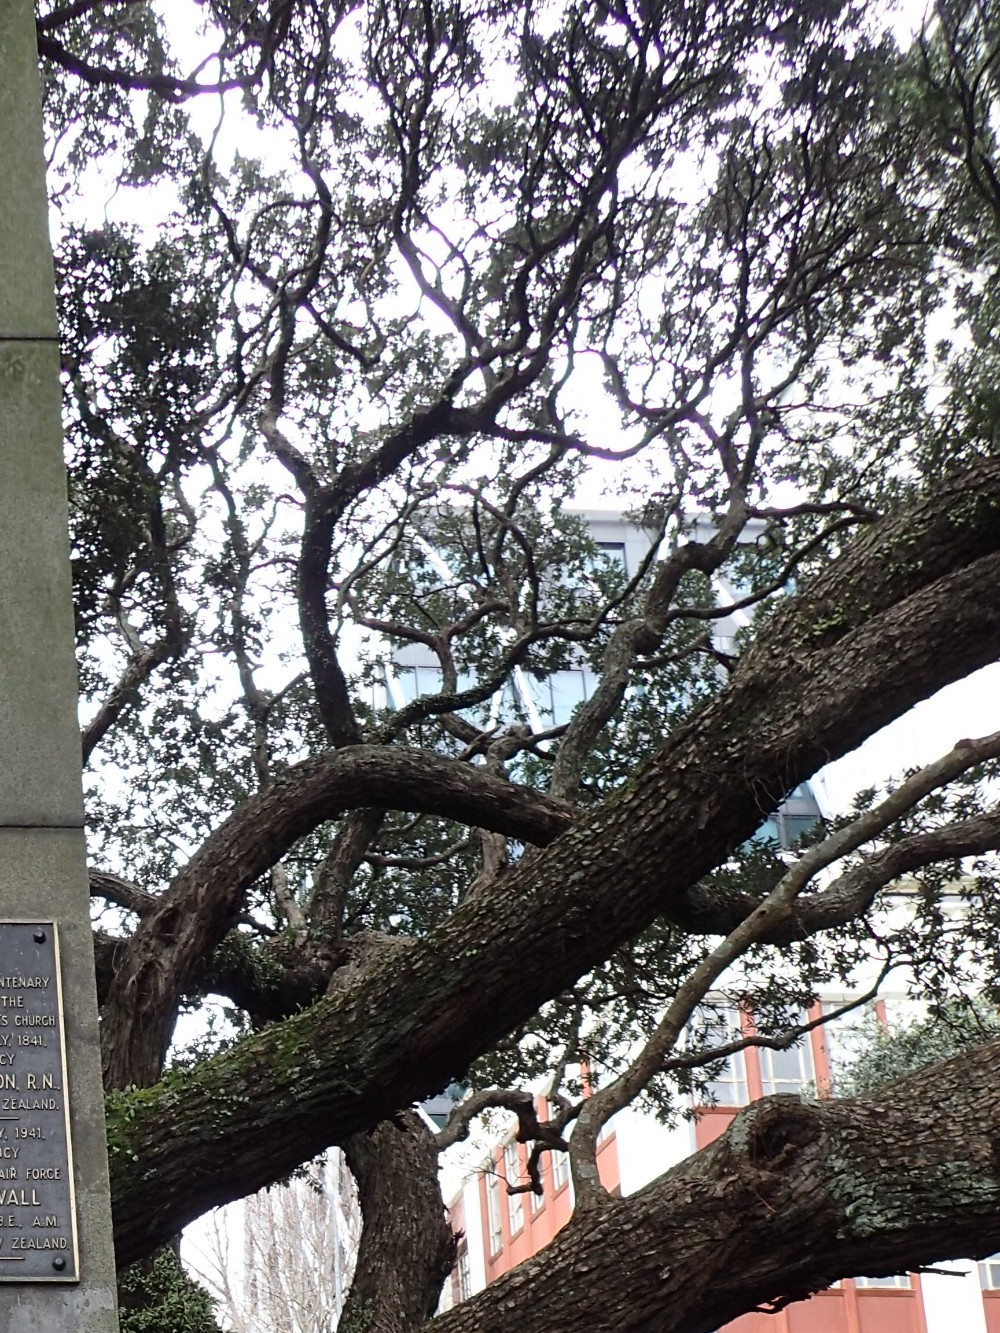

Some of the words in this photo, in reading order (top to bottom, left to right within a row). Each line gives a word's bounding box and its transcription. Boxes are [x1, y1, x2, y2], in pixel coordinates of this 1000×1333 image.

[1, 996, 24, 1008] THE
[14, 1015, 55, 1026] CHURCH
[2, 1099, 60, 1110] ZEALAND.
[26, 1168, 61, 1180] FORCE
[11, 1238, 70, 1251] ZEALAND.
